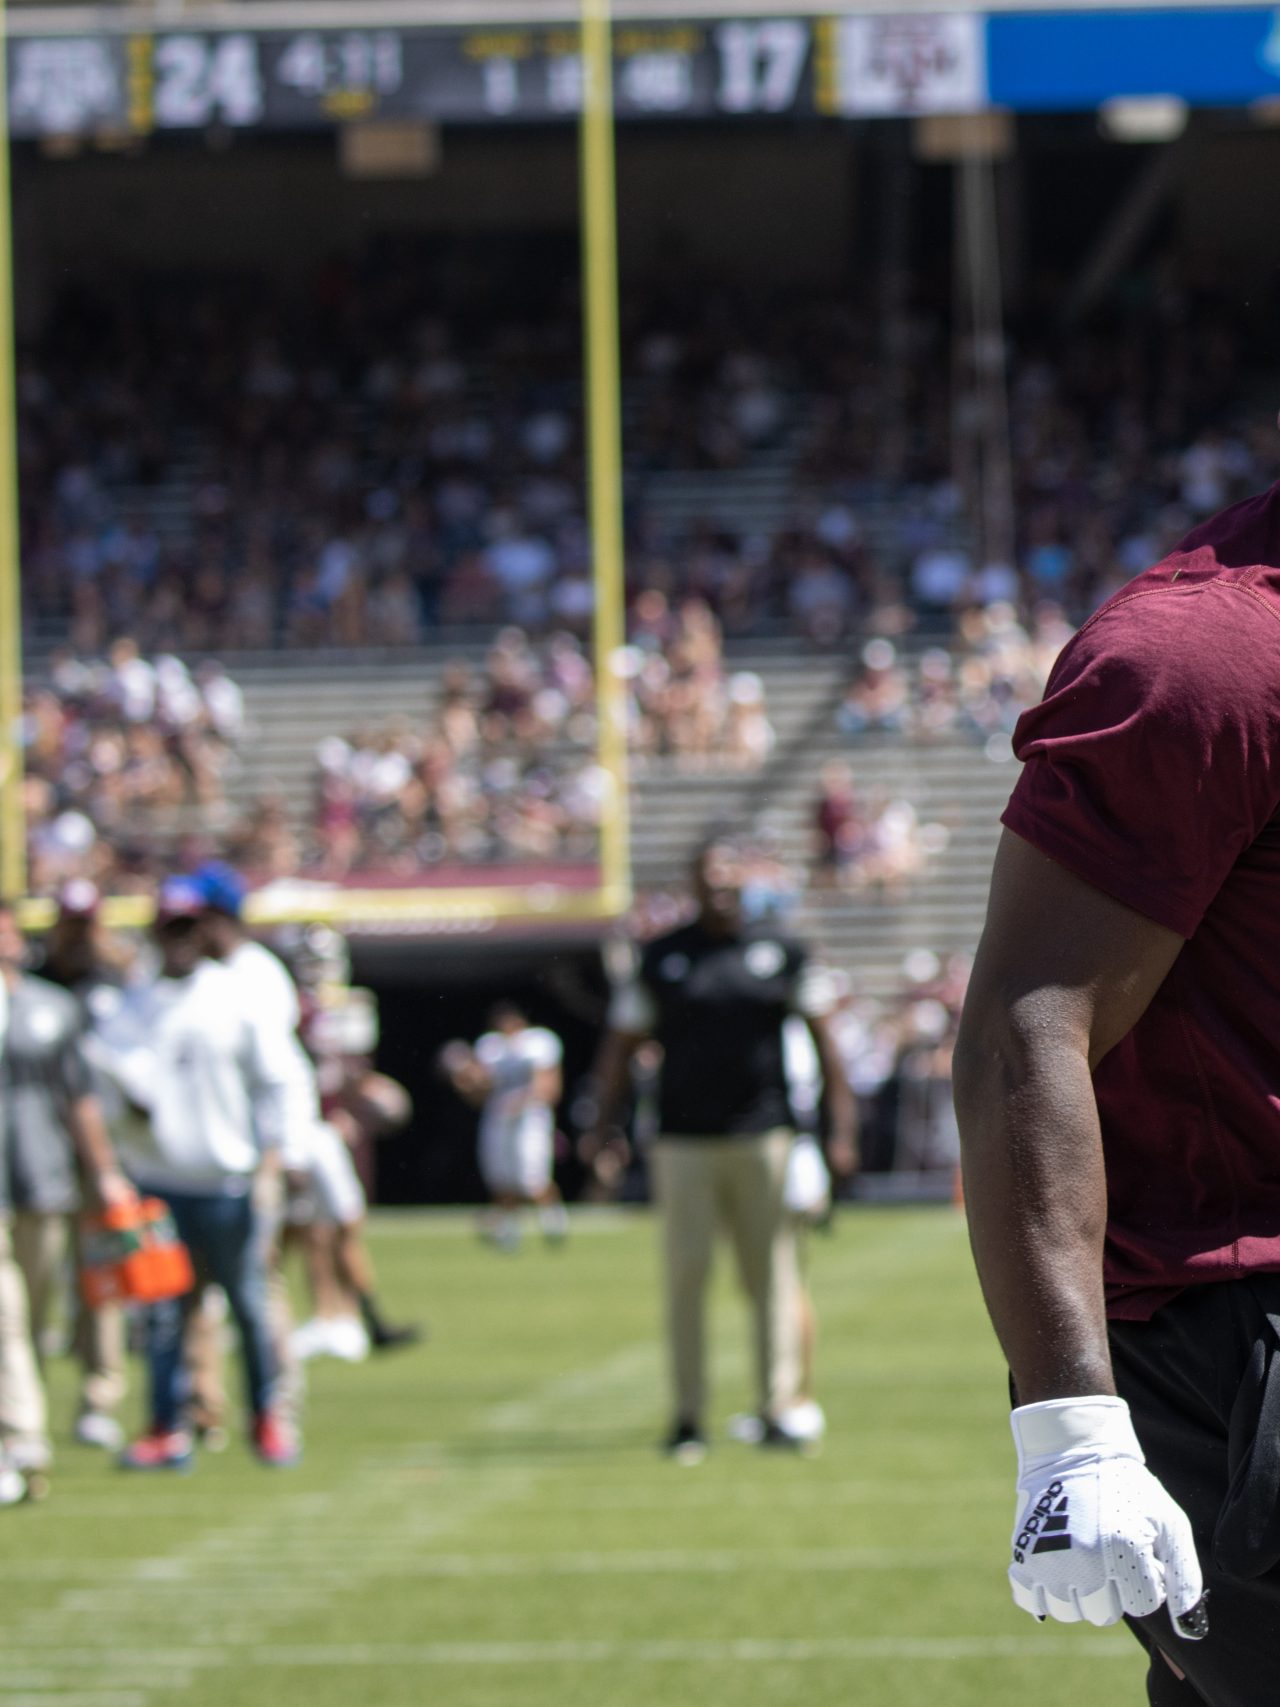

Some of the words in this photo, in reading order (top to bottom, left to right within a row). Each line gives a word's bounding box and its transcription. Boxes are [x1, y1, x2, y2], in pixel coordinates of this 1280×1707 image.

[155, 34, 261, 127] 24
[717, 21, 808, 112] 17
[1015, 1481, 1062, 1564] adidas
